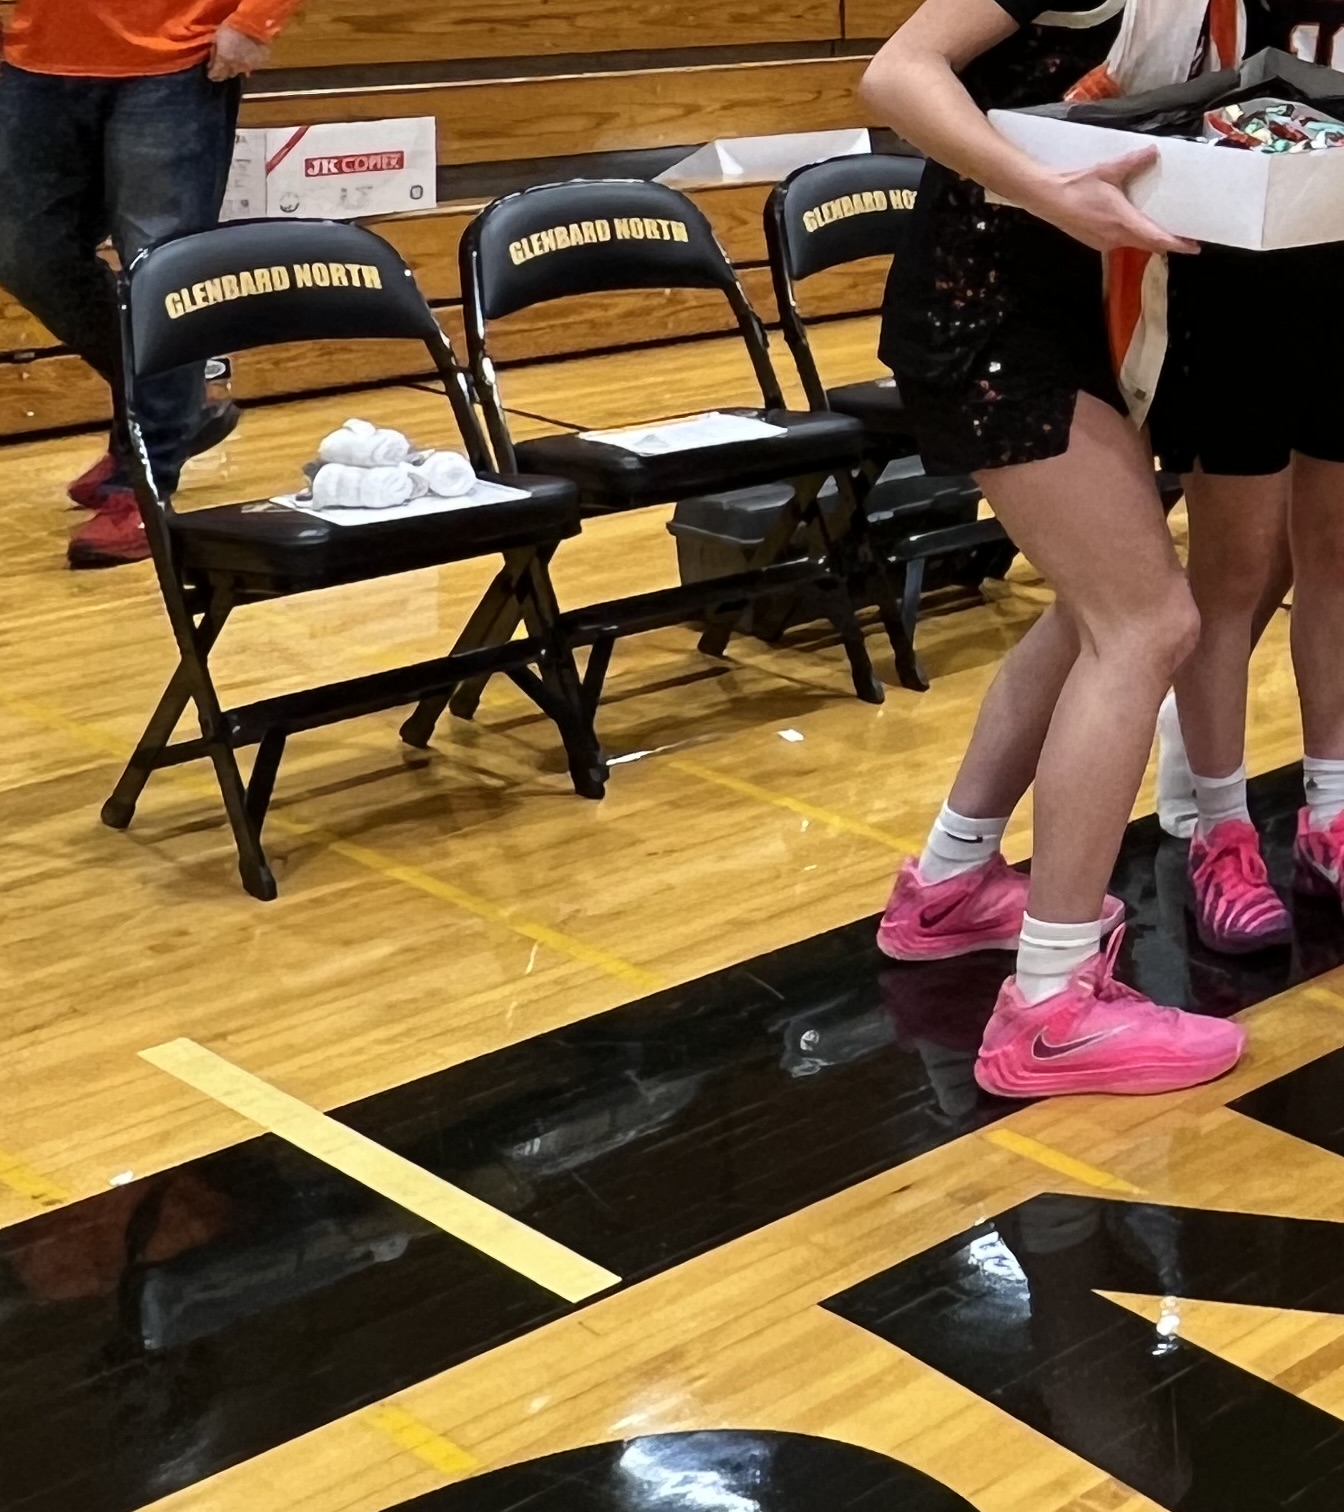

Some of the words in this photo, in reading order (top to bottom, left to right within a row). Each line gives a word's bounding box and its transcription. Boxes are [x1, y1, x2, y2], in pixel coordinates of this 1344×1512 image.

[307, 159, 339, 176] JK
[802, 189, 887, 233] GLENBARD
[509, 219, 610, 265] GLENBARD
[614, 217, 689, 243] NORTH
[165, 266, 290, 319] GLENBARD
[293, 263, 382, 289] NORTH
